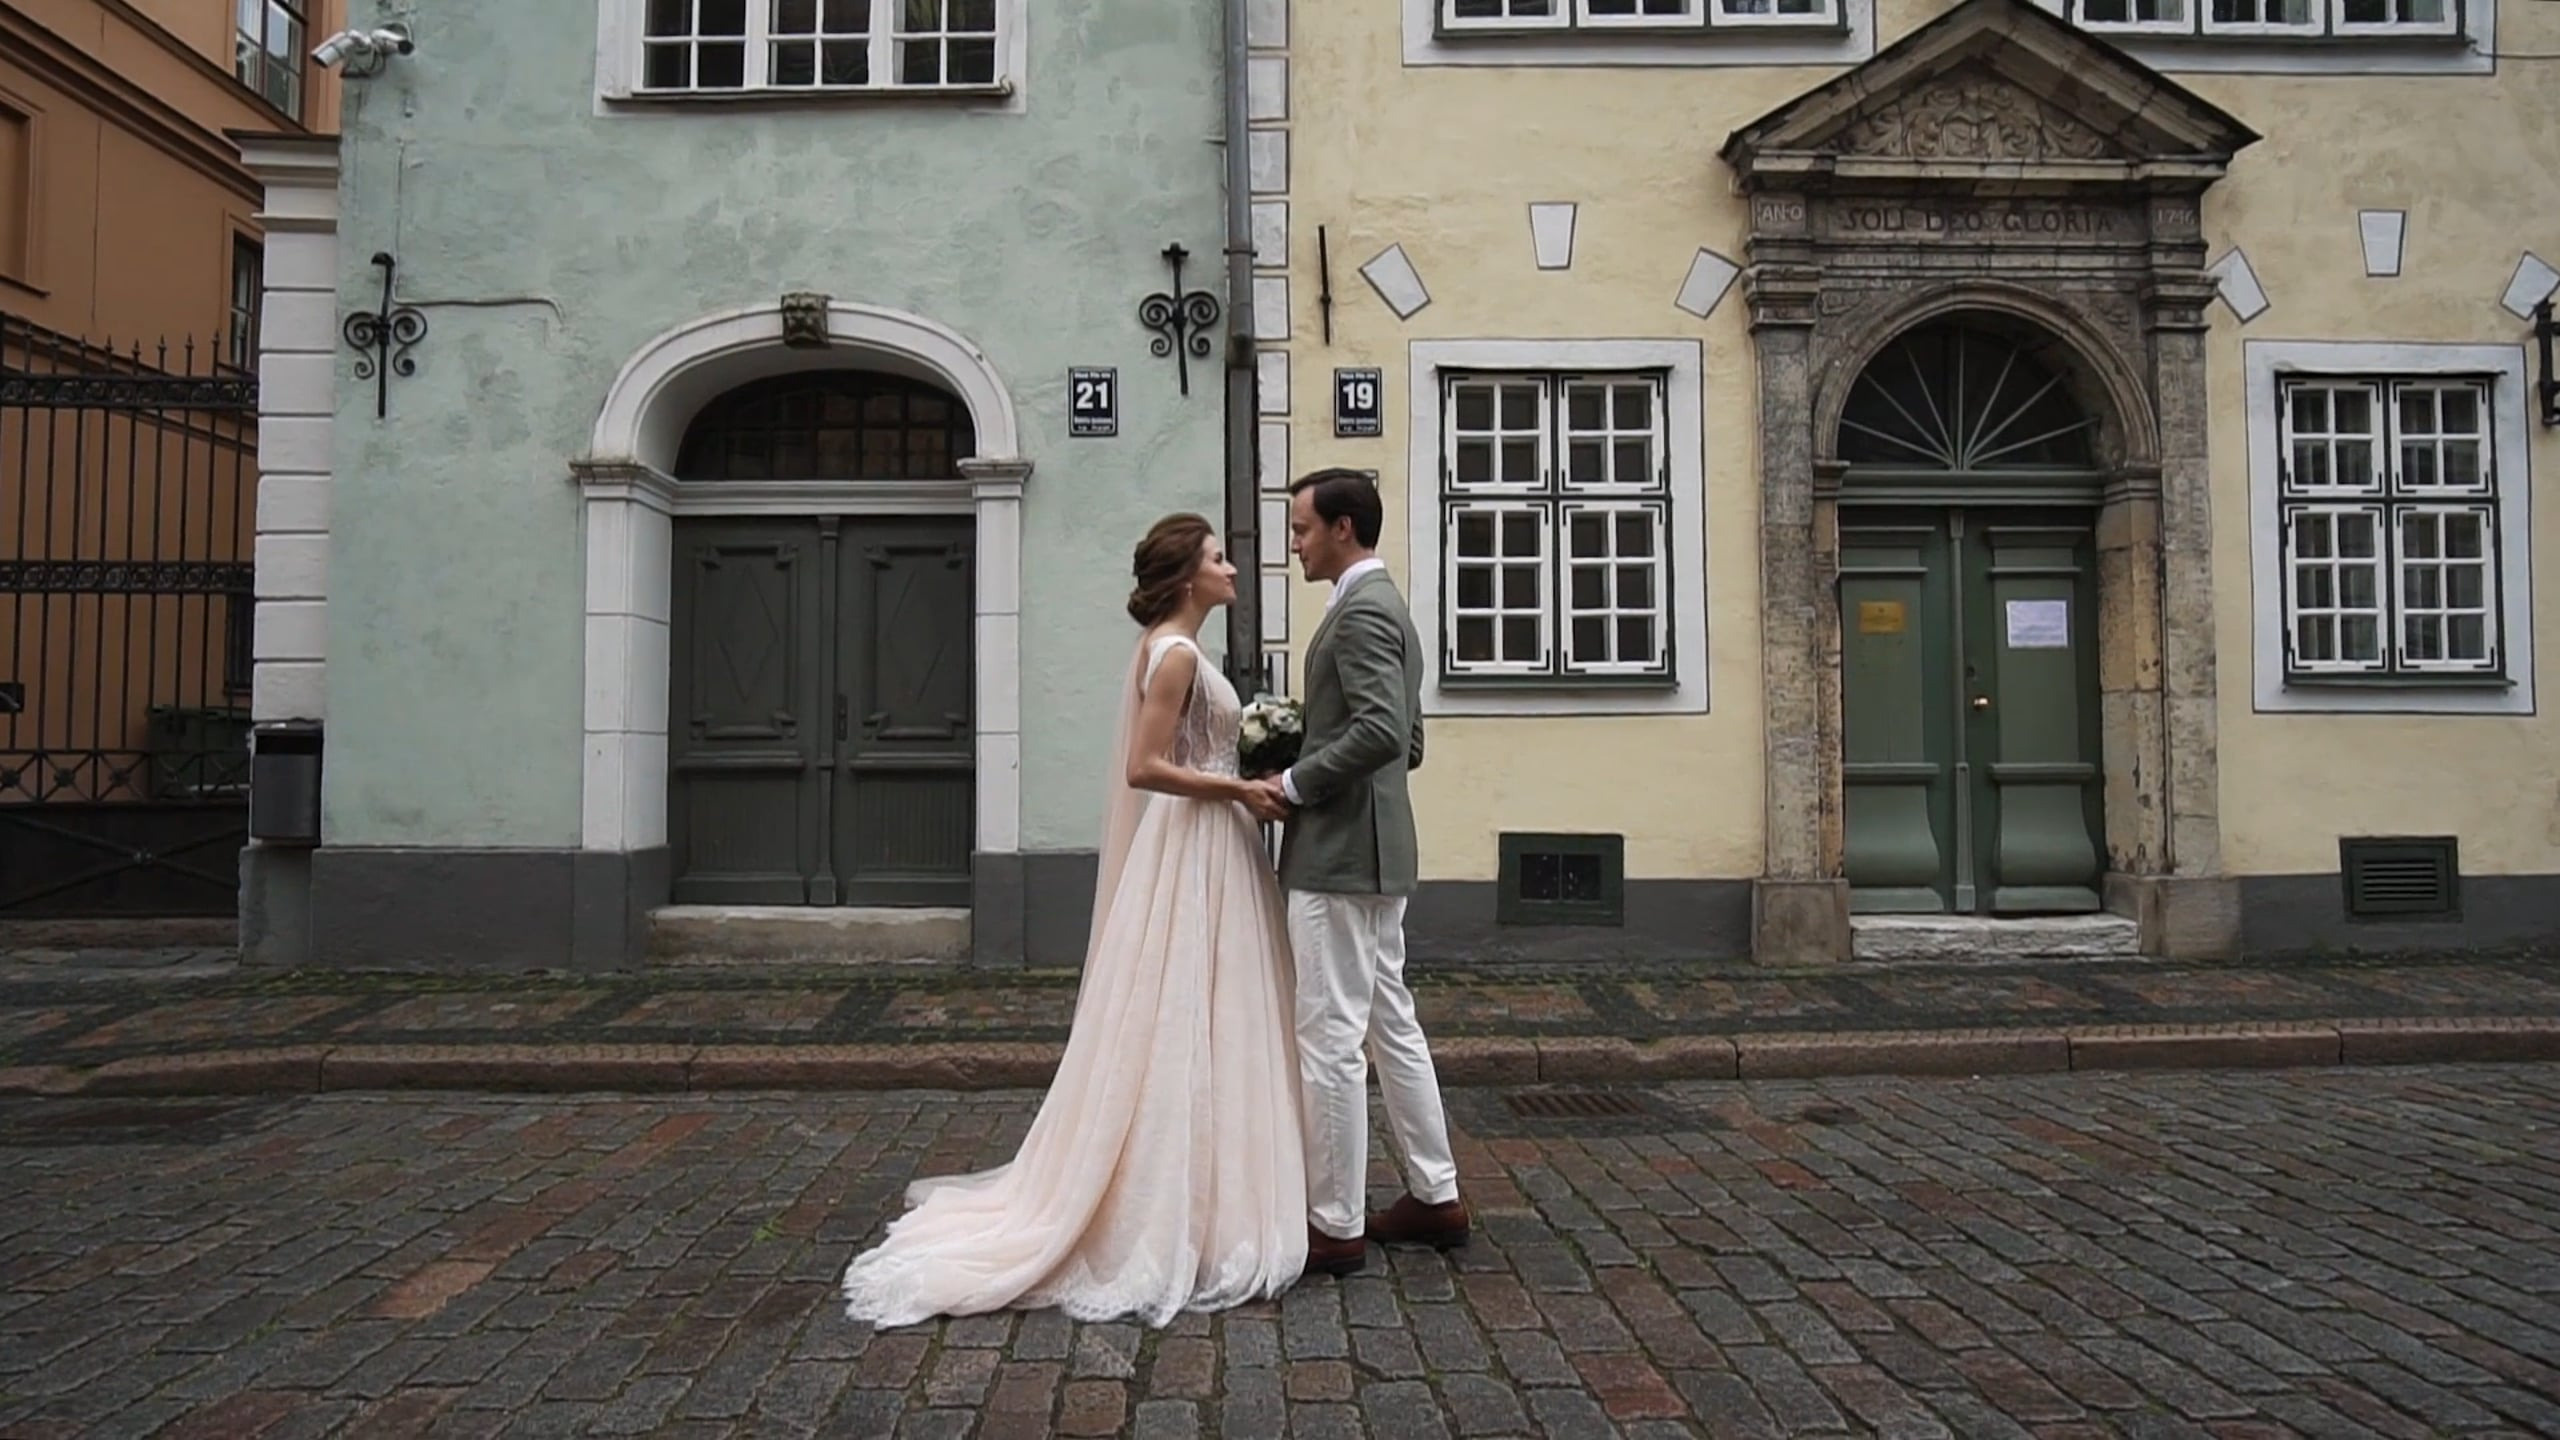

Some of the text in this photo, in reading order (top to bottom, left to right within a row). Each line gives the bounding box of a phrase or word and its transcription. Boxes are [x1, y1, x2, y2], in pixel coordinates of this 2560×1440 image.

[1925, 209, 1983, 232] DEO
[2002, 209, 2113, 233] GLORIA
[1076, 381, 1108, 409] 21
[1342, 382, 1374, 409] 19
